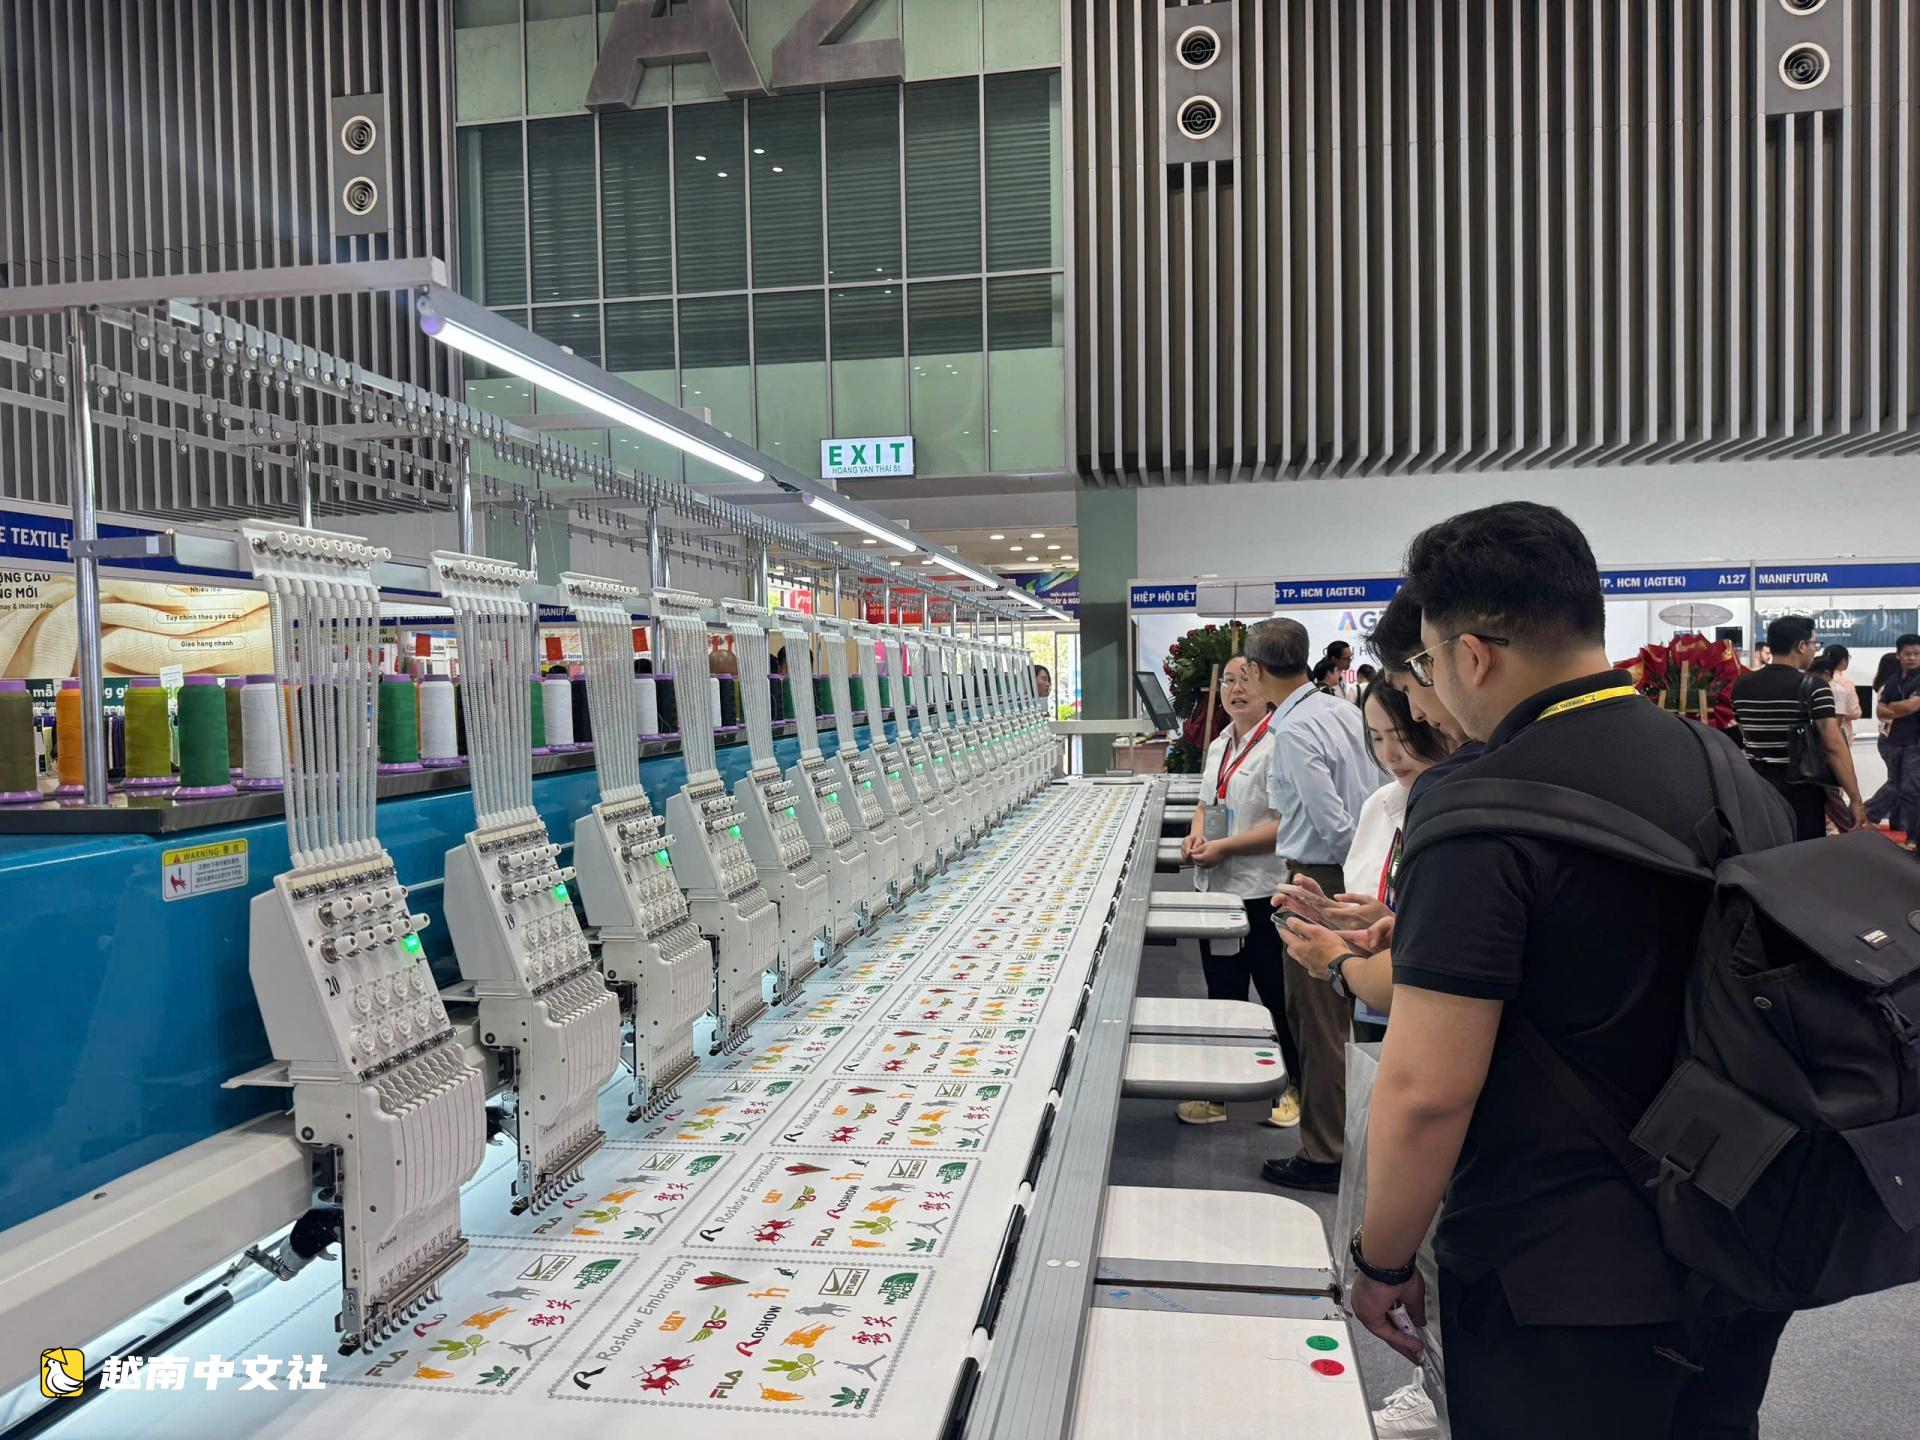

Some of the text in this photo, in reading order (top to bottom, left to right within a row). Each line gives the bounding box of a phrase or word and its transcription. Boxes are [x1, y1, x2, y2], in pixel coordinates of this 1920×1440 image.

[829, 442, 905, 466] EXIT
[832, 466, 858, 475] HOANG
[876, 465, 892, 473] THAI
[11, 527, 69, 550] TEXTILE
[0, 572, 21, 586] NG
[1617, 577, 1640, 587] HCM
[1644, 576, 1686, 588] (AGTEK)
[1718, 574, 1746, 585] A127
[1759, 573, 1828, 584] MANIFUTURA
[16, 585, 38, 598] MỚI
[1133, 591, 1155, 603] HIỆP
[1158, 591, 1175, 603] HỘI
[1178, 591, 1196, 602] DỆT
[1283, 589, 1298, 599] TP.
[1301, 588, 1323, 598] HCM
[1326, 586, 1366, 598] (AGTEK)
[184, 847, 219, 861] WARNING
[504, 914, 516, 931] 19
[324, 975, 341, 997] 20
[532, 1216, 563, 1234] FILA
[810, 1228, 835, 1246] FILA
[877, 1281, 892, 1294] THE
[897, 1282, 915, 1299] FACE
[595, 1319, 644, 1361] Roshow
[636, 1261, 697, 1315] Embroidery
[736, 1305, 782, 1358] ROSHOW
[365, 1349, 409, 1377] FILA
[709, 1369, 744, 1399] FILA
[853, 1387, 871, 1410] adidas
